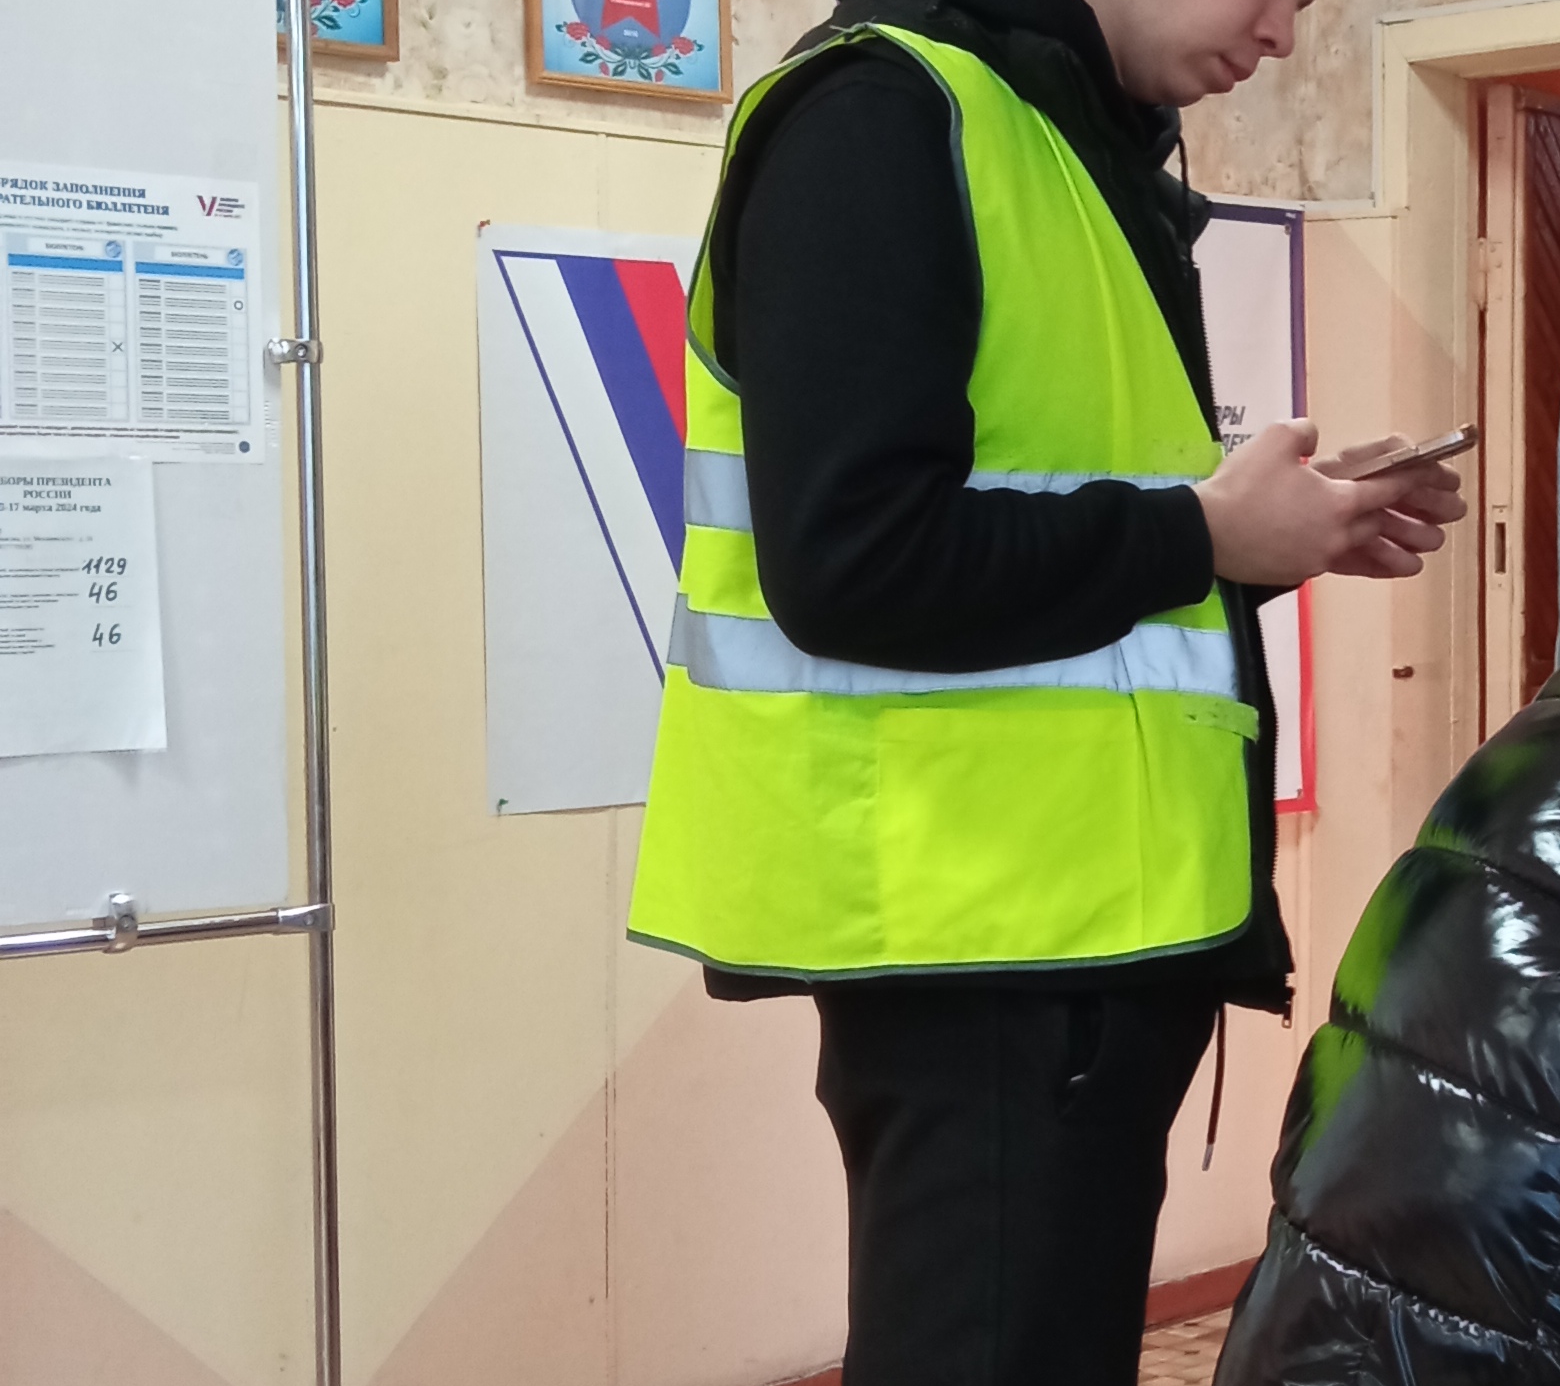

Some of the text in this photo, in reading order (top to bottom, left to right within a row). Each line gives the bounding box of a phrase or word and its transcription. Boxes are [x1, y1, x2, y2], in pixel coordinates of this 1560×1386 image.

[52, 180, 146, 199] ЗАПОЛНЕНИЯ
[86, 199, 170, 216] БЮЛЛЕТЕНЯ
[36, 477, 112, 488] ПРЕЗИДЕНТА
[23, 489, 72, 499] РОССИИ
[22, 504, 53, 514] марта
[55, 503, 77, 512] 2024
[79, 505, 102, 513] года
[82, 556, 127, 576] 1129
[88, 581, 118, 604] 46
[92, 623, 122, 647] 46
